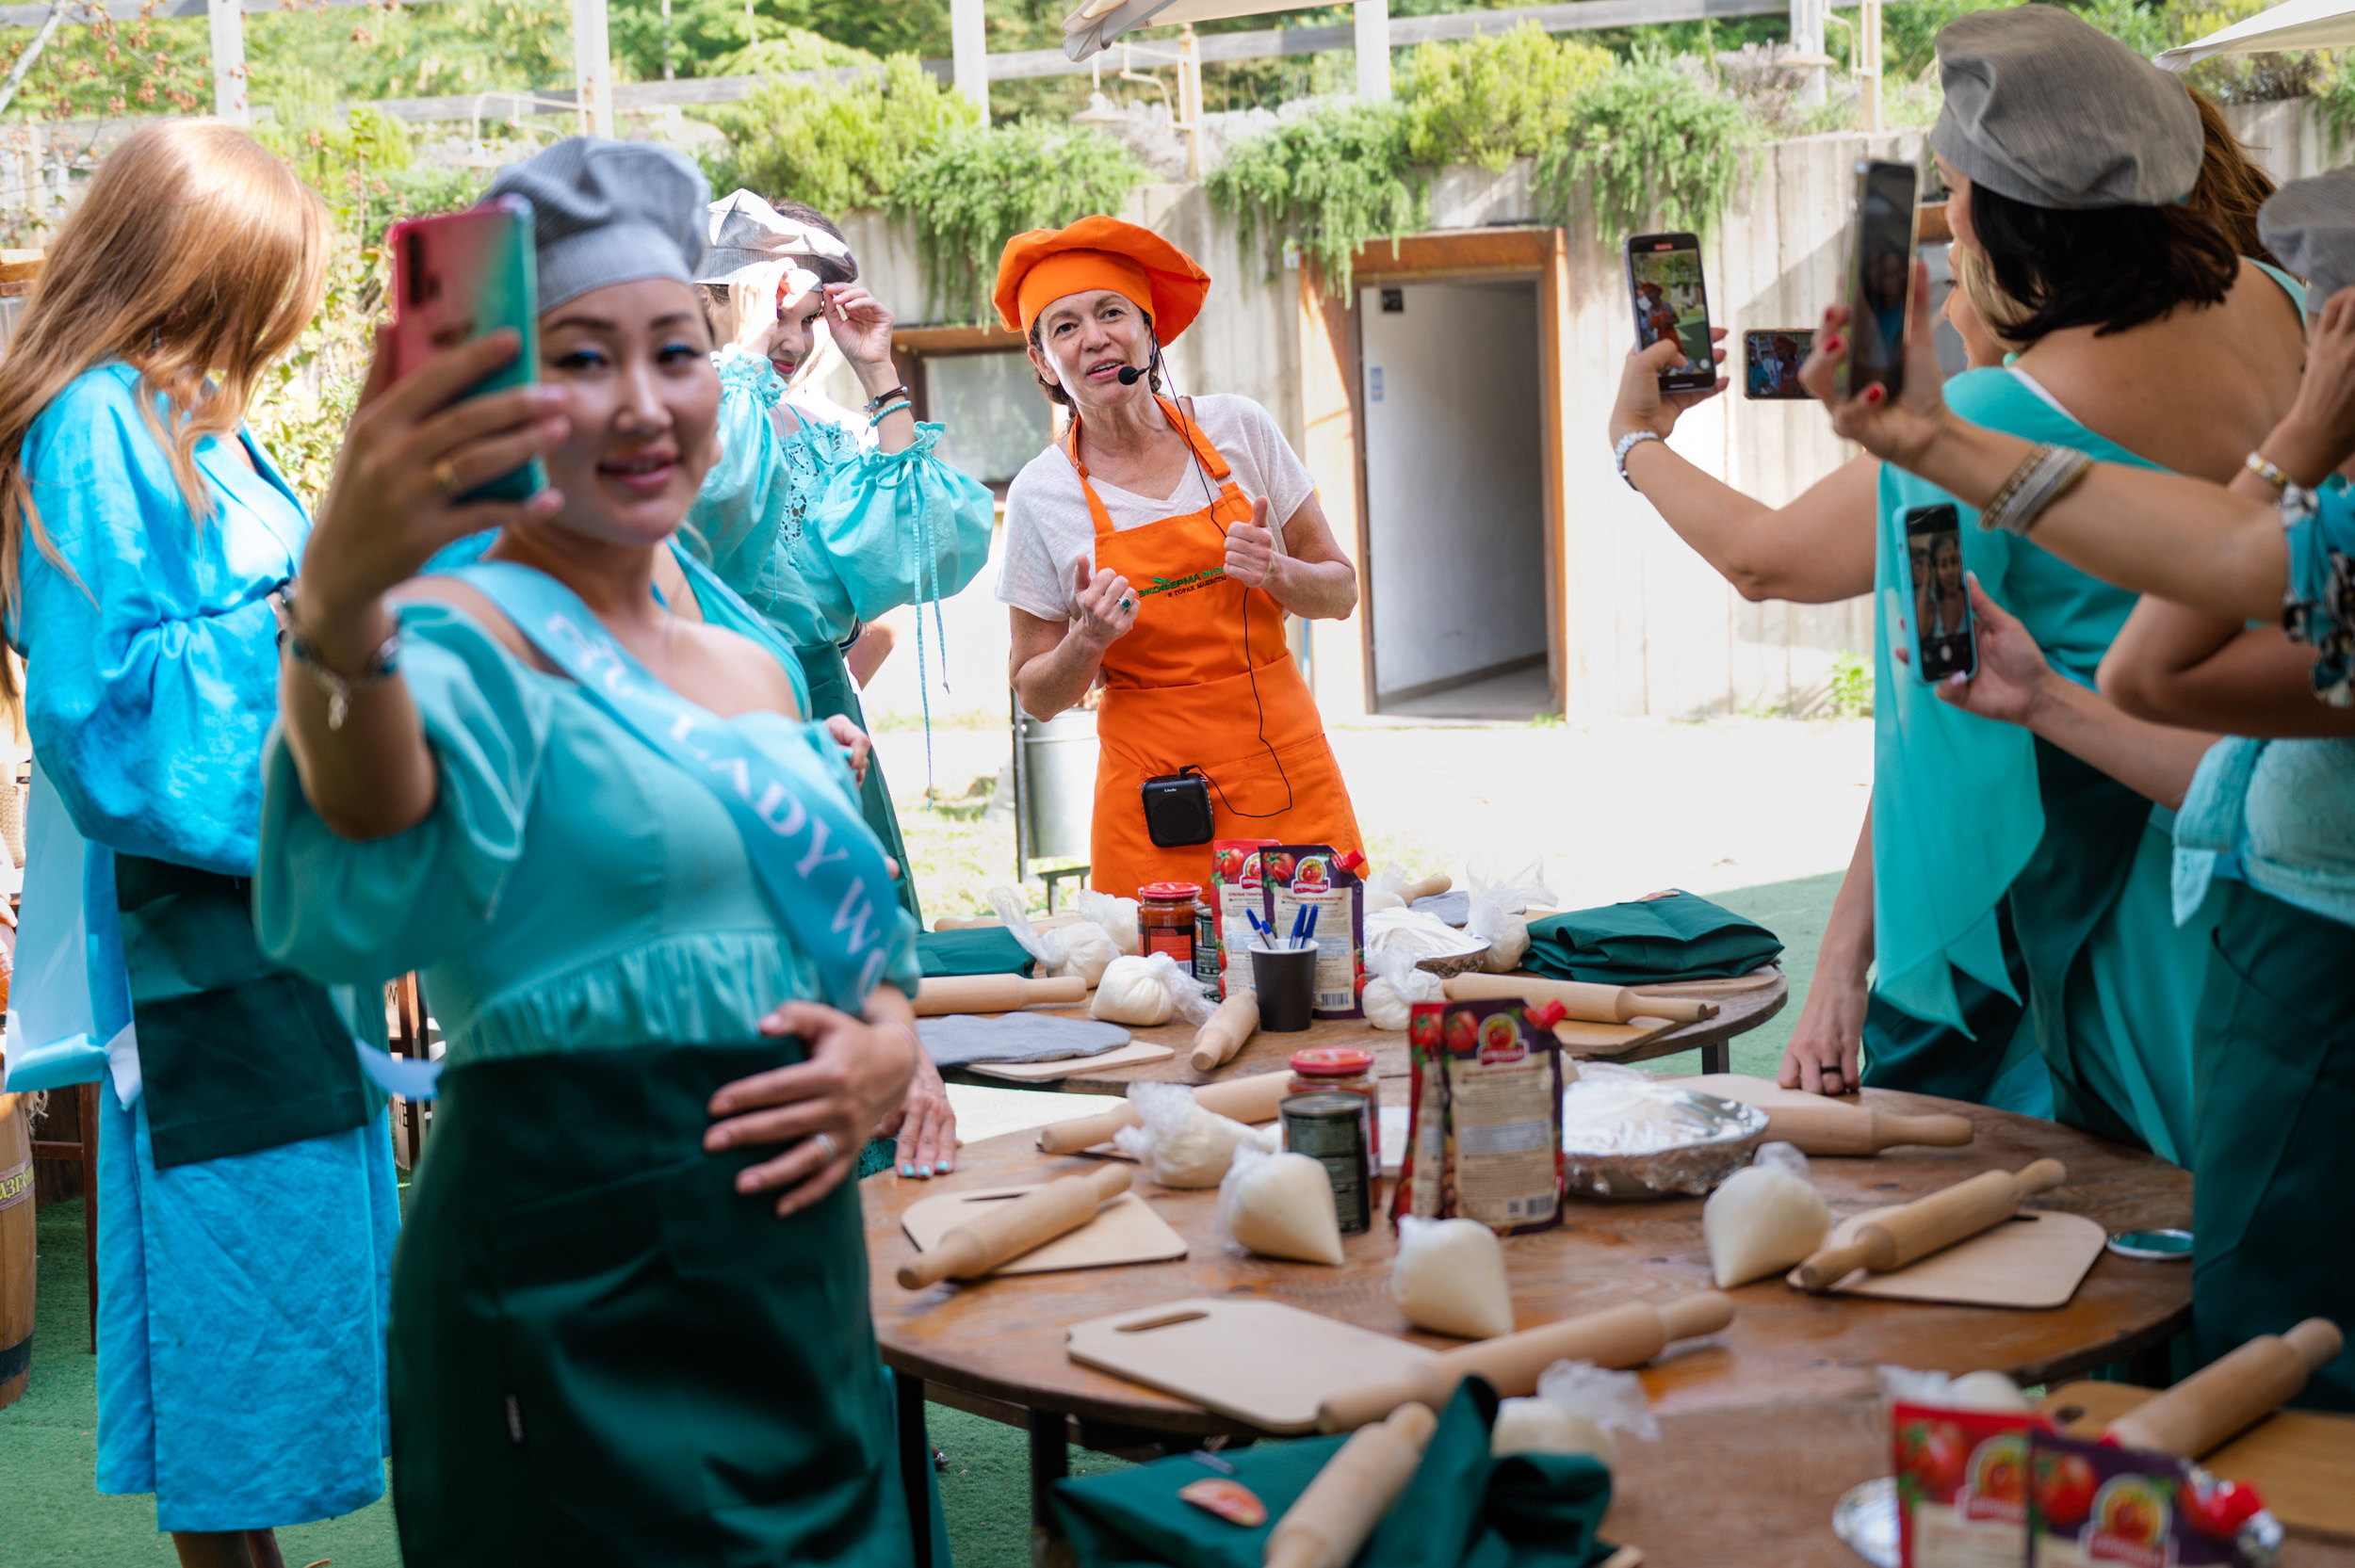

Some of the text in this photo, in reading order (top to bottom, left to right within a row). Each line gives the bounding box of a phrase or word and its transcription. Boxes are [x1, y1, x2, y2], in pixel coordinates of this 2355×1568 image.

[1138, 567, 1225, 598] ЭКОФЕРМА ЭКЗ
[668, 713, 850, 880] LADY
